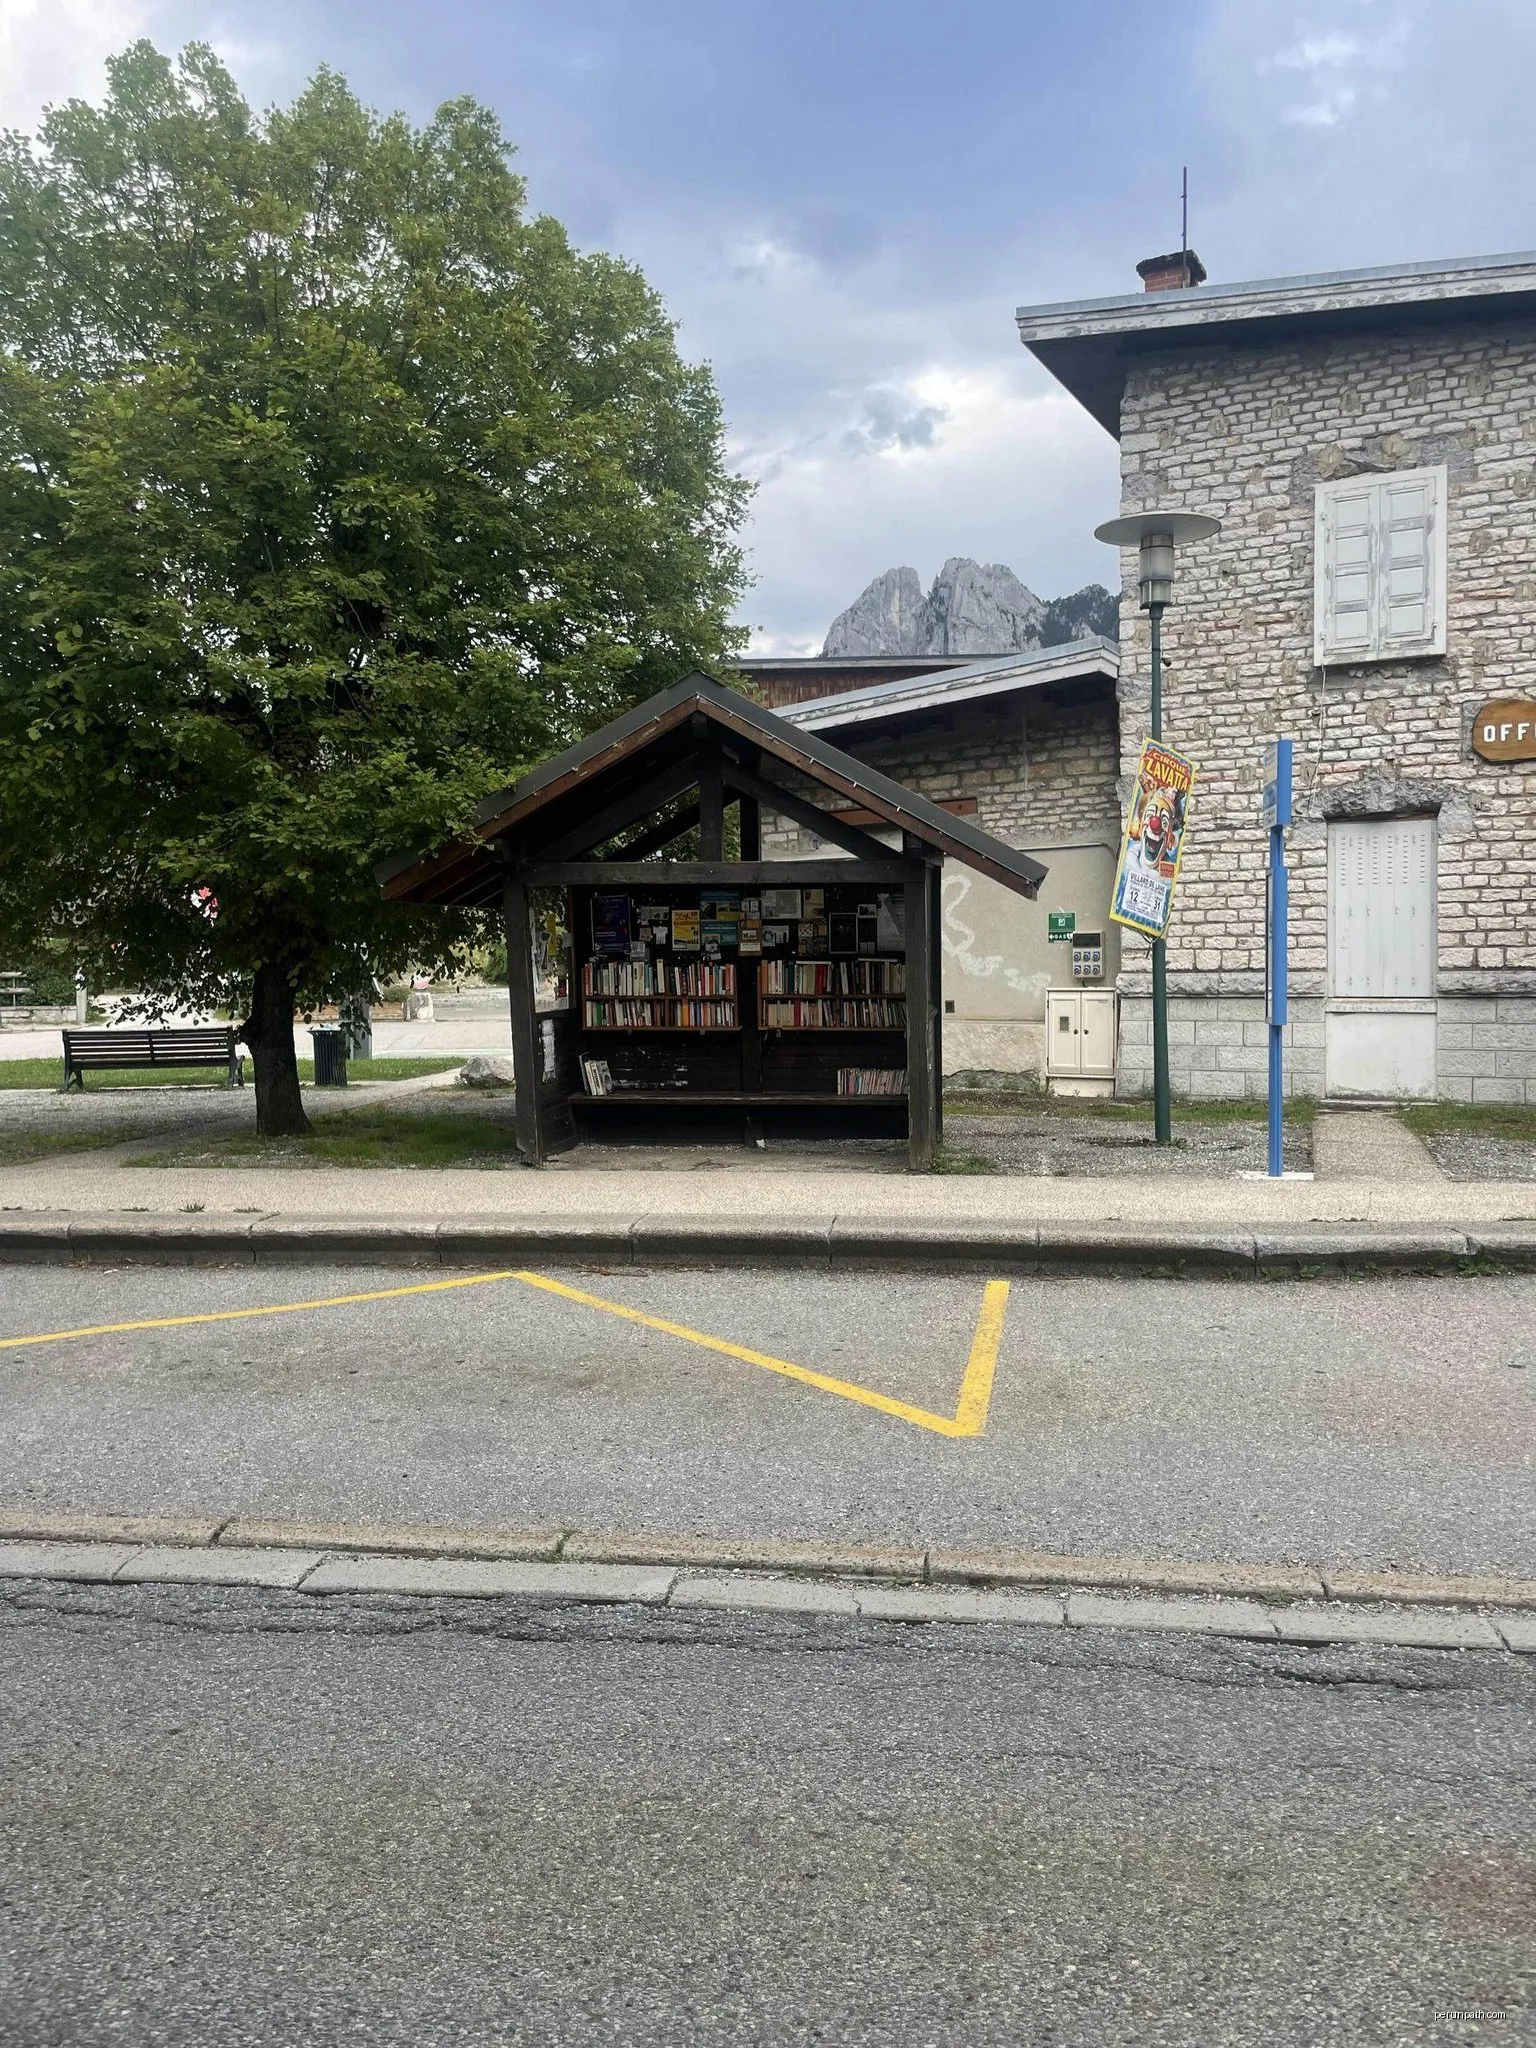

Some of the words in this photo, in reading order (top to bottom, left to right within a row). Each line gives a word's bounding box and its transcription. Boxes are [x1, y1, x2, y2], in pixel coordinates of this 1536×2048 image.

[1145, 757, 1189, 791] ZAVATTA
[1152, 752, 1187, 774] CIRQUE
[1130, 890, 1139, 903] 12
